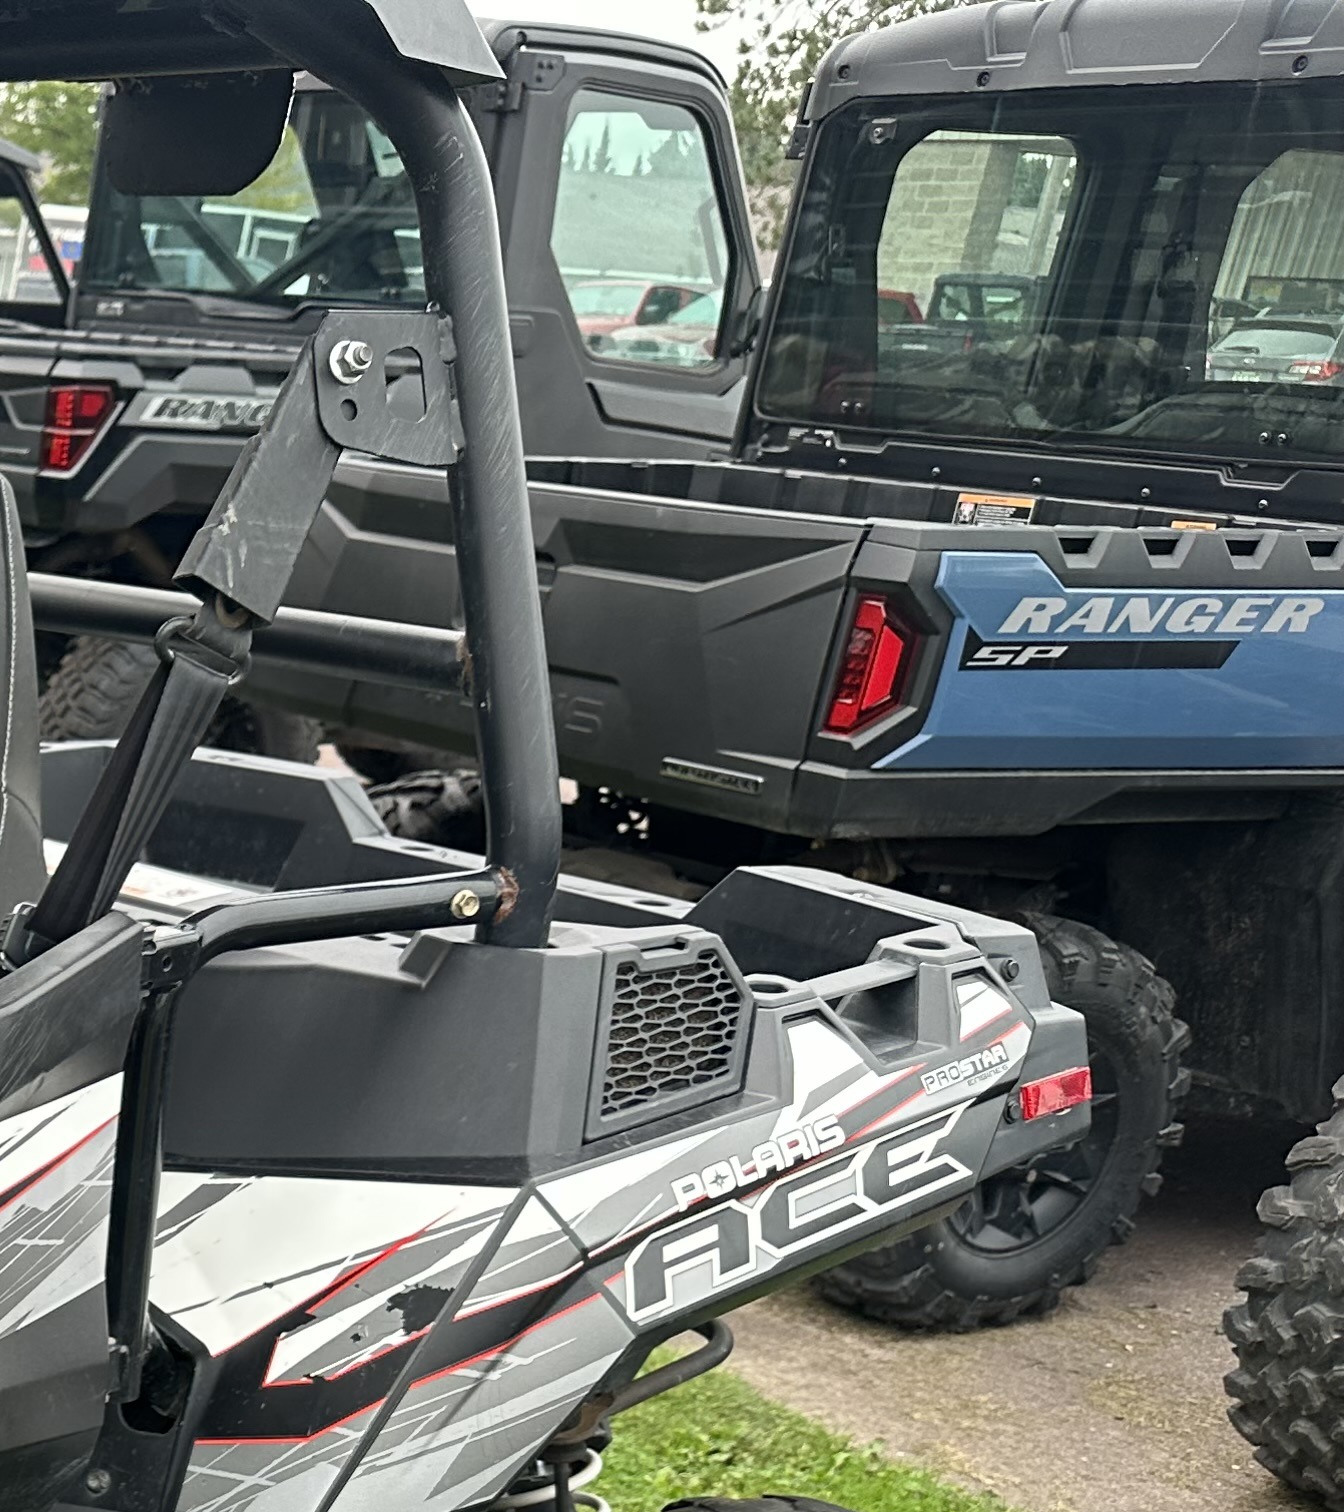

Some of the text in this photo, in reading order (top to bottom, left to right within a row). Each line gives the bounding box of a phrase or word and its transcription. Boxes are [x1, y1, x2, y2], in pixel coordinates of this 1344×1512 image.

[997, 597, 1325, 633] RANGER
[966, 646, 1069, 666] SP
[920, 1044, 1010, 1096] PROSTAR
[670, 1114, 846, 1212] POLARIS
[624, 1098, 975, 1322] ACE
